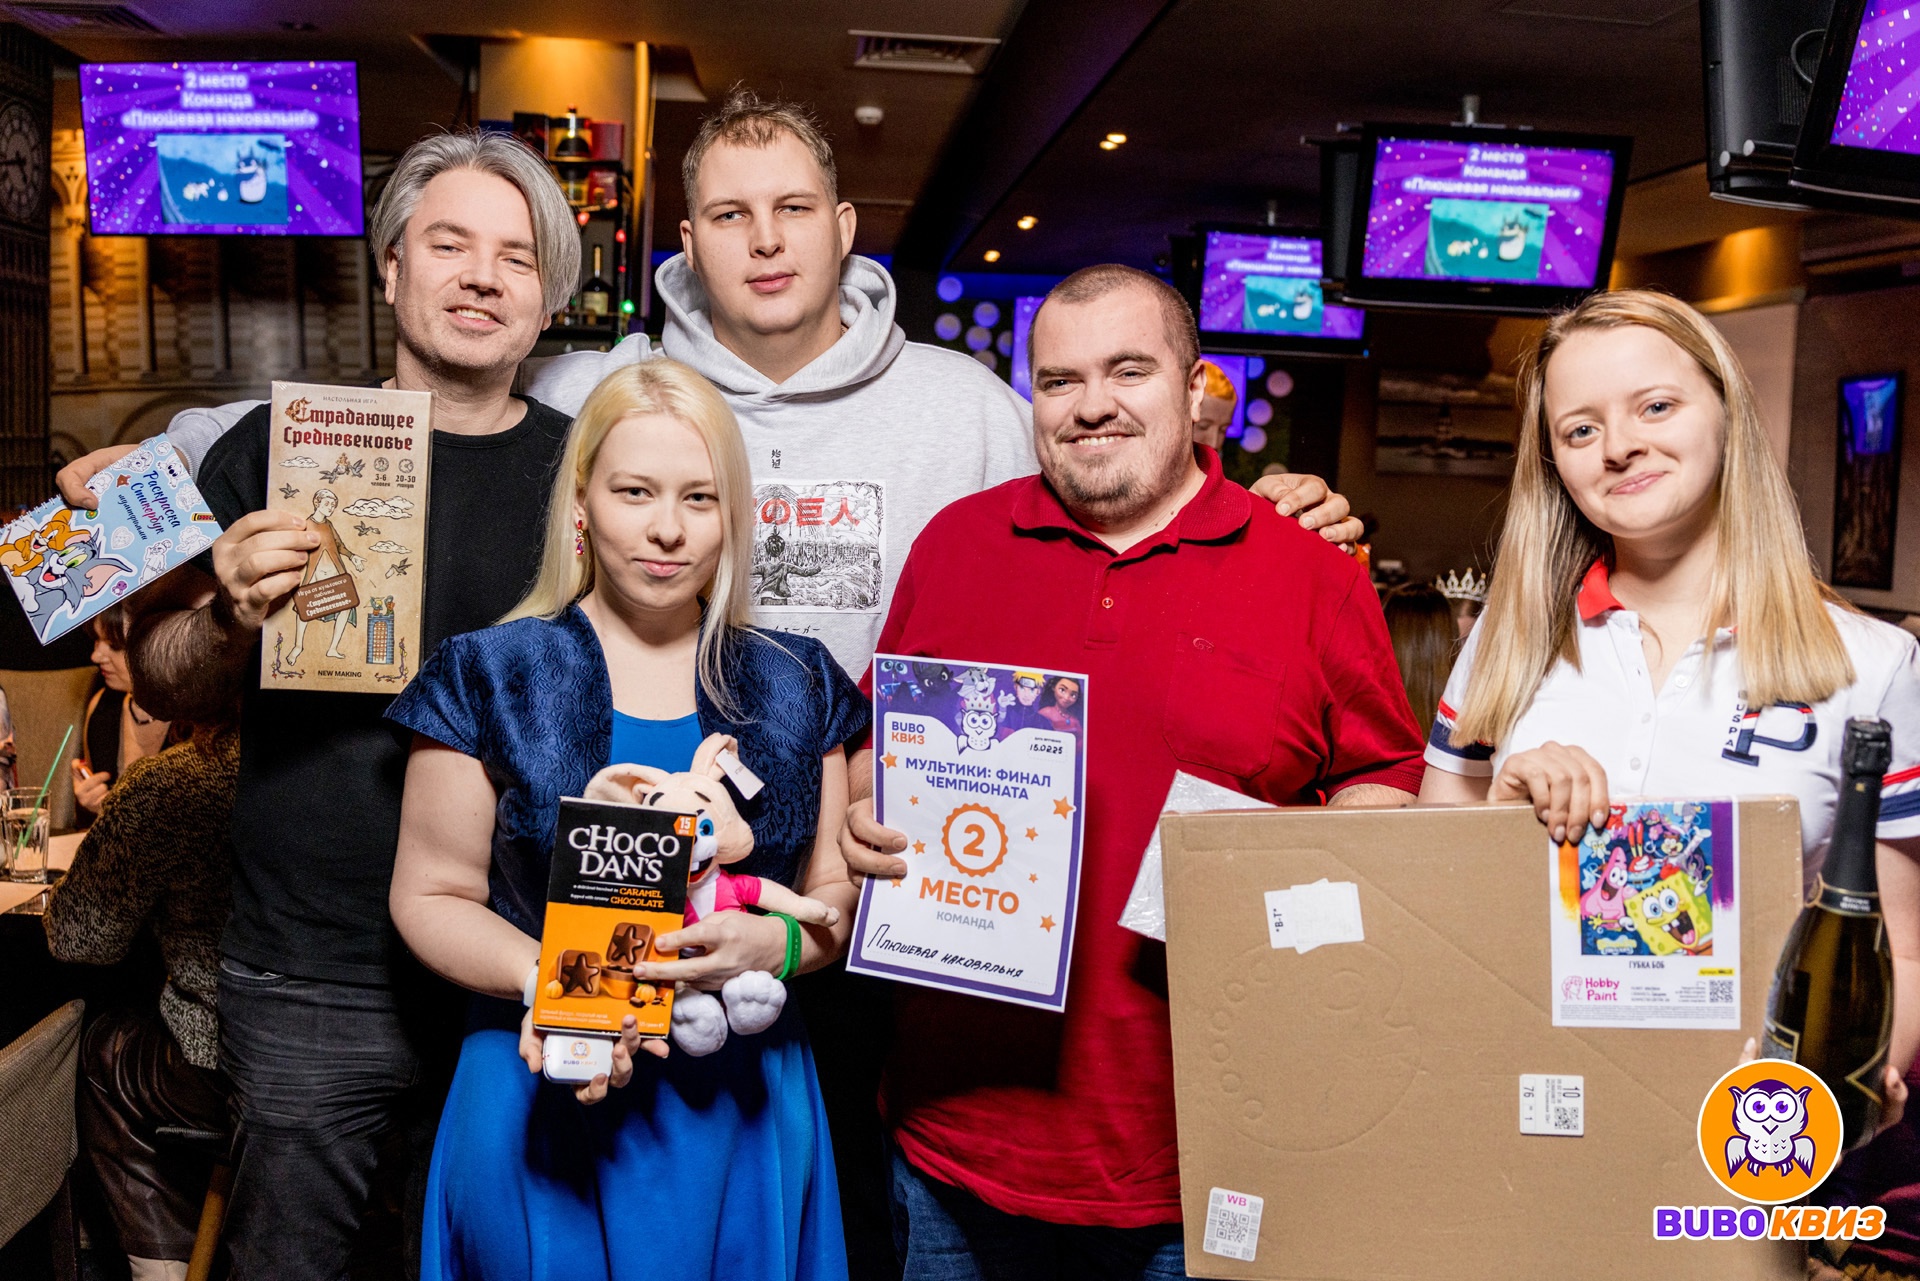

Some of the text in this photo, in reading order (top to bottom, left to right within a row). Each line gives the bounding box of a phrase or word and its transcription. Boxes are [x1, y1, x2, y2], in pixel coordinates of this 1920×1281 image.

[285, 397, 415, 430] Страдающее
[283, 426, 413, 451] Средневековье
[375, 473, 387, 481] 3-6
[395, 474, 416, 483] 20-30
[143, 470, 181, 528] Раскраска
[130, 482, 165, 535] Стикербук
[753, 497, 860, 527] の巨人
[334, 670, 362, 678] MAKING
[892, 721, 925, 734] BUBO
[891, 732, 925, 745] КВИЗ
[906, 757, 1052, 788] МУЛЬТИКИ: ФИНАЛ
[926, 775, 1029, 800] ЧЕМПИОНАТА
[680, 817, 691, 829] 15
[568, 825, 681, 858] CHOCO
[963, 823, 986, 857] 2
[579, 851, 663, 882] DAN'S
[619, 887, 663, 898] CARAMEL
[919, 877, 1019, 915] МЕСТО
[610, 896, 664, 908] CHOCOLATE
[936, 911, 995, 930] КОМАНДА
[1629, 961, 1665, 969] ГУБКА БОБ
[1585, 977, 1620, 990] Hobby
[1587, 989, 1618, 1001] Paint
[1562, 1086, 1581, 1098] 10
[1227, 1194, 1247, 1207] WB
